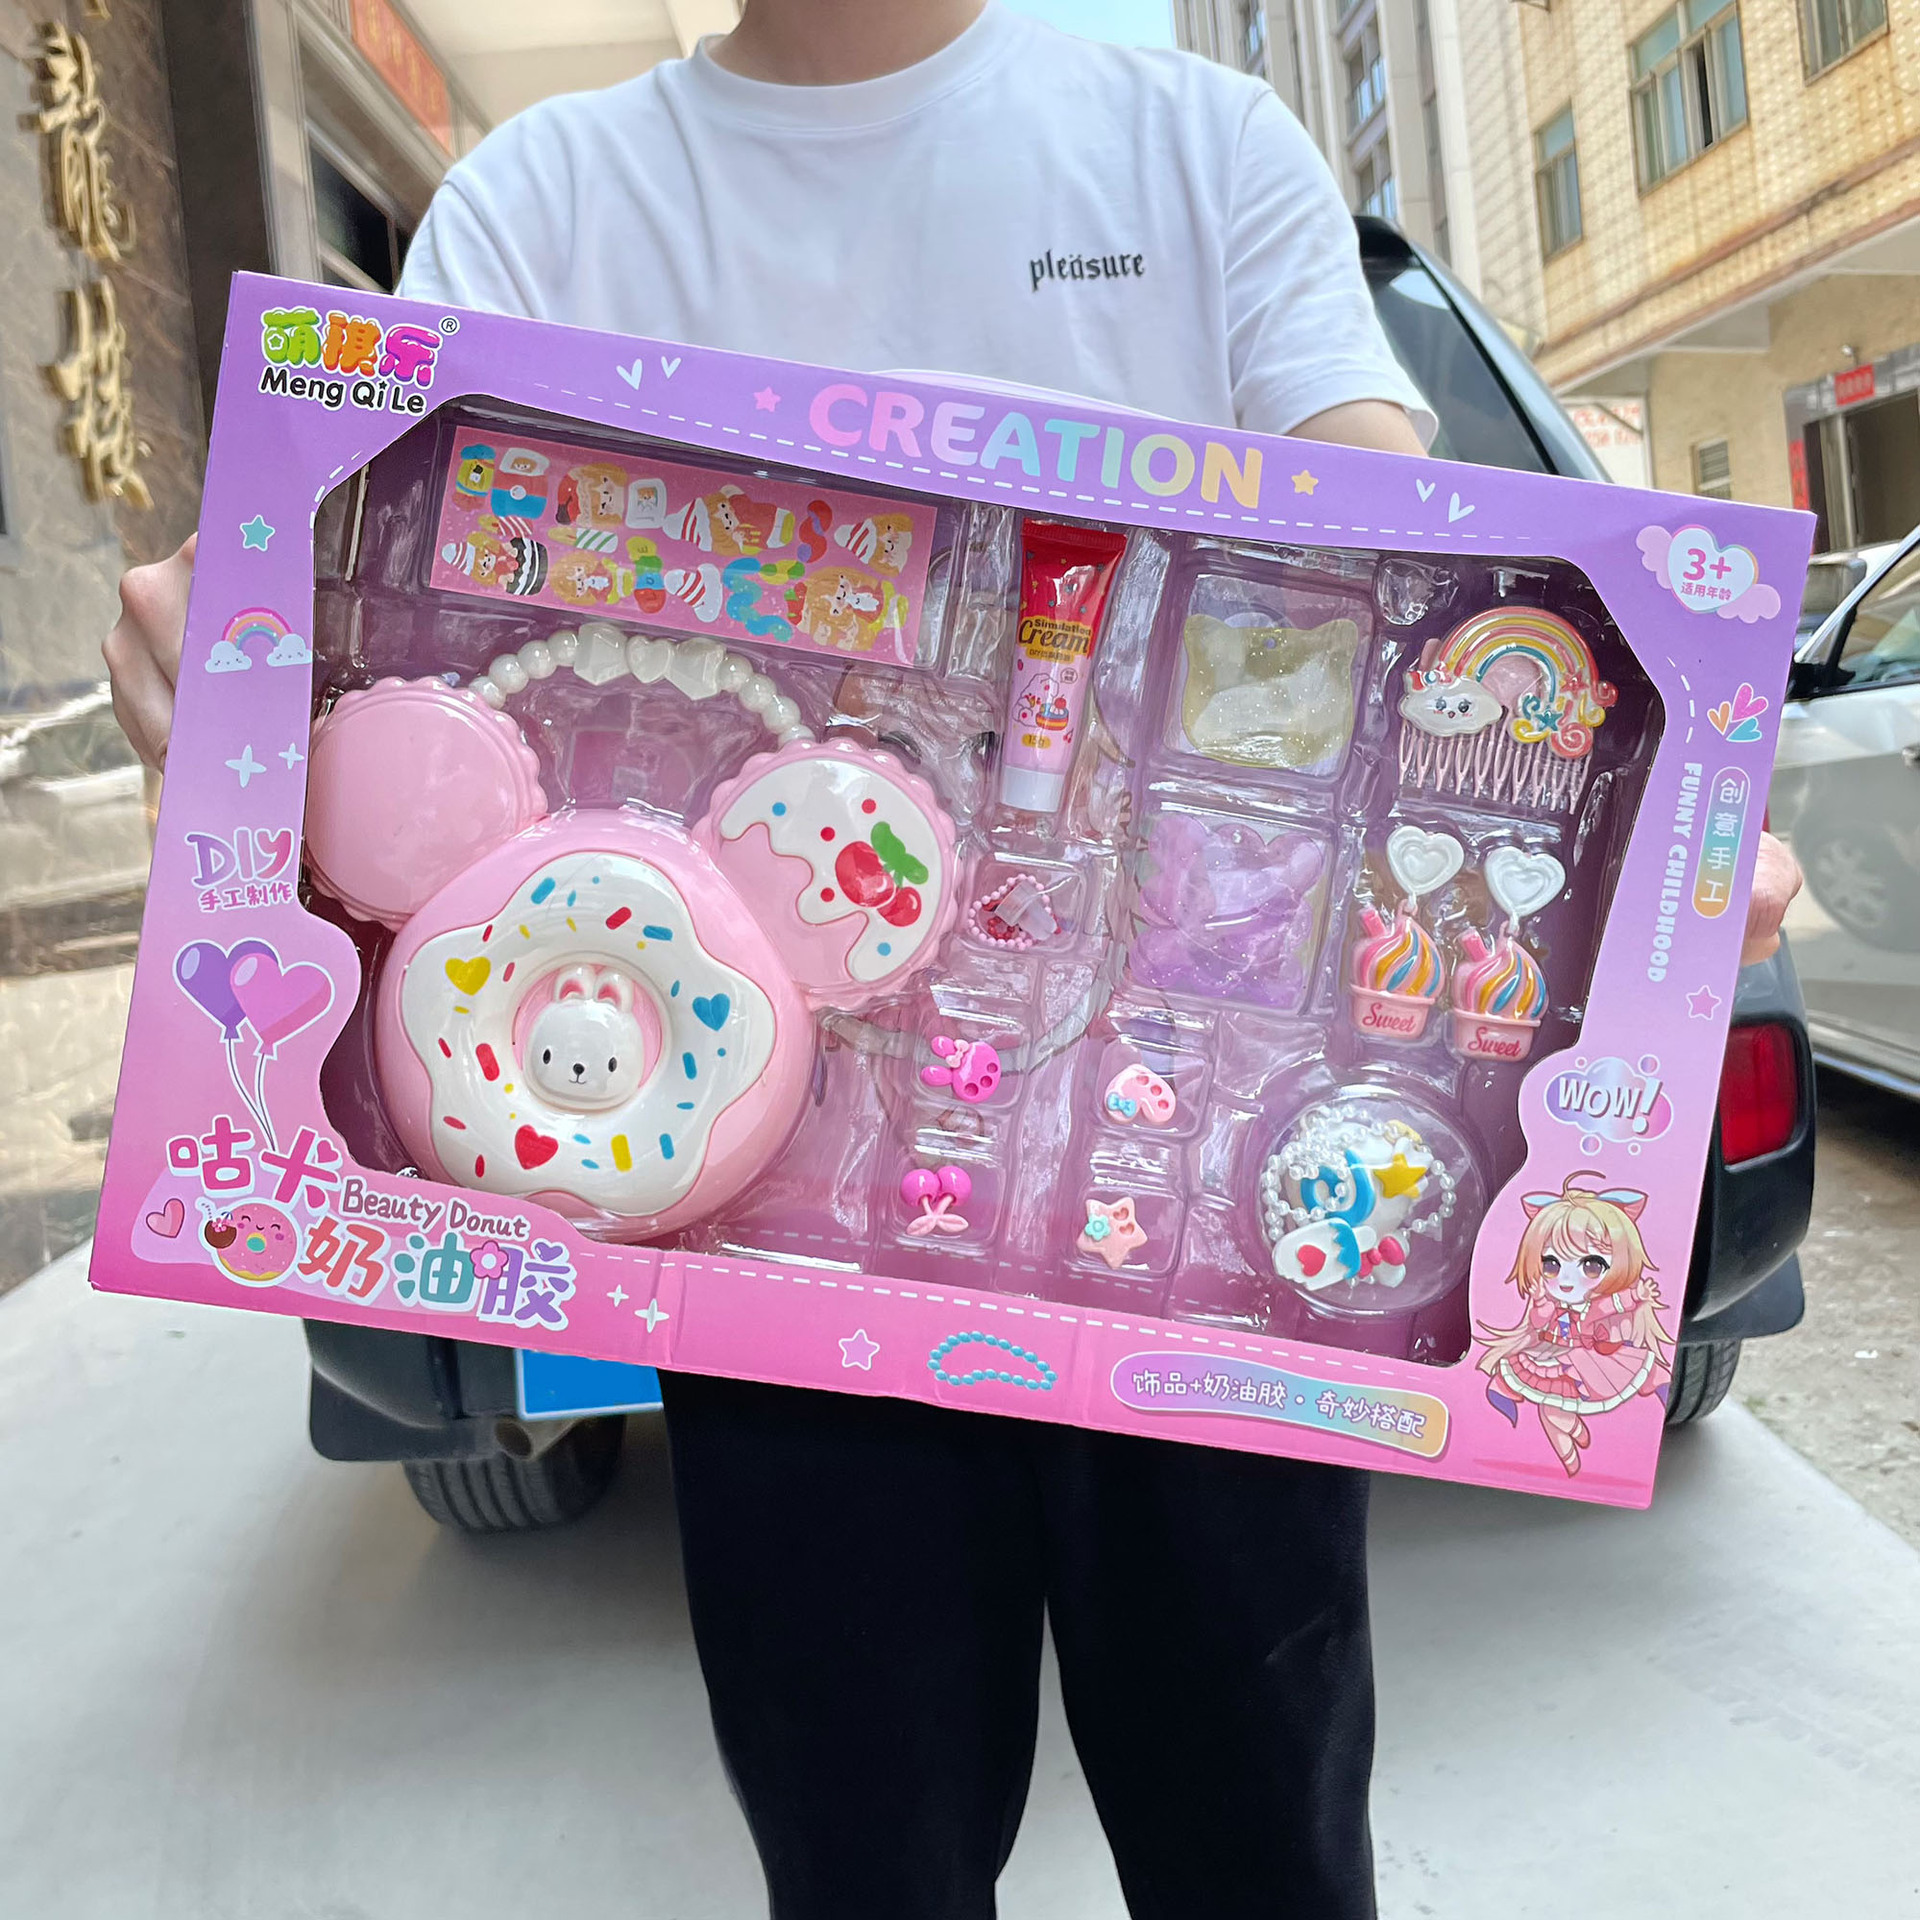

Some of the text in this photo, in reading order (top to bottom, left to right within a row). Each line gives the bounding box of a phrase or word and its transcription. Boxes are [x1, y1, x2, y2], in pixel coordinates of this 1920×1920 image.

[261, 367, 424, 414] Meng Qi Le
[809, 384, 1263, 509] CREATION
[1683, 548, 1732, 581] 3+
[1680, 582, 1732, 601] 适用年龄
[1018, 619, 1089, 654] Cream
[186, 830, 292, 885] DIY
[1647, 762, 1703, 982] FUNNY CHILDHOOD
[199, 882, 293, 911] 手工制作
[1362, 1002, 1416, 1033] Sweet
[1467, 1026, 1521, 1057] Sweet
[1558, 1076, 1663, 1135] WOW!
[168, 1116, 341, 1211] 咕卡
[342, 1178, 528, 1239] Beauty Donut
[297, 1215, 573, 1325] 奶油胶
